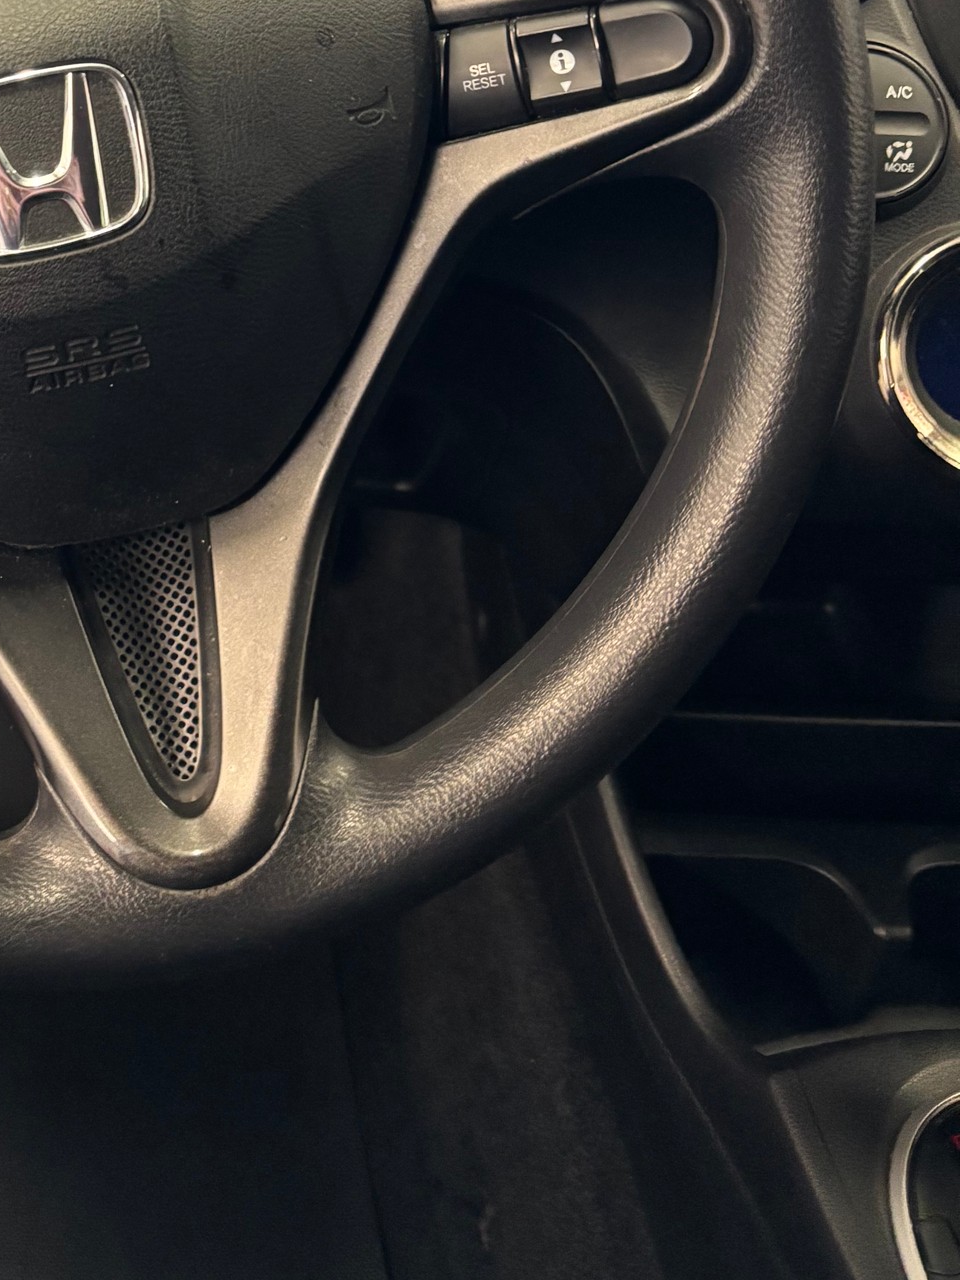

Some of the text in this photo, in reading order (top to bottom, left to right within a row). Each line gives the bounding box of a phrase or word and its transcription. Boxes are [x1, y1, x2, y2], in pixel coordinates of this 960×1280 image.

[469, 62, 496, 78] SEL
[462, 73, 506, 92] RESET
[885, 84, 914, 99] A/C
[884, 161, 915, 173] MODE
[24, 324, 144, 368] SRS
[28, 350, 151, 395] AIRBAG
